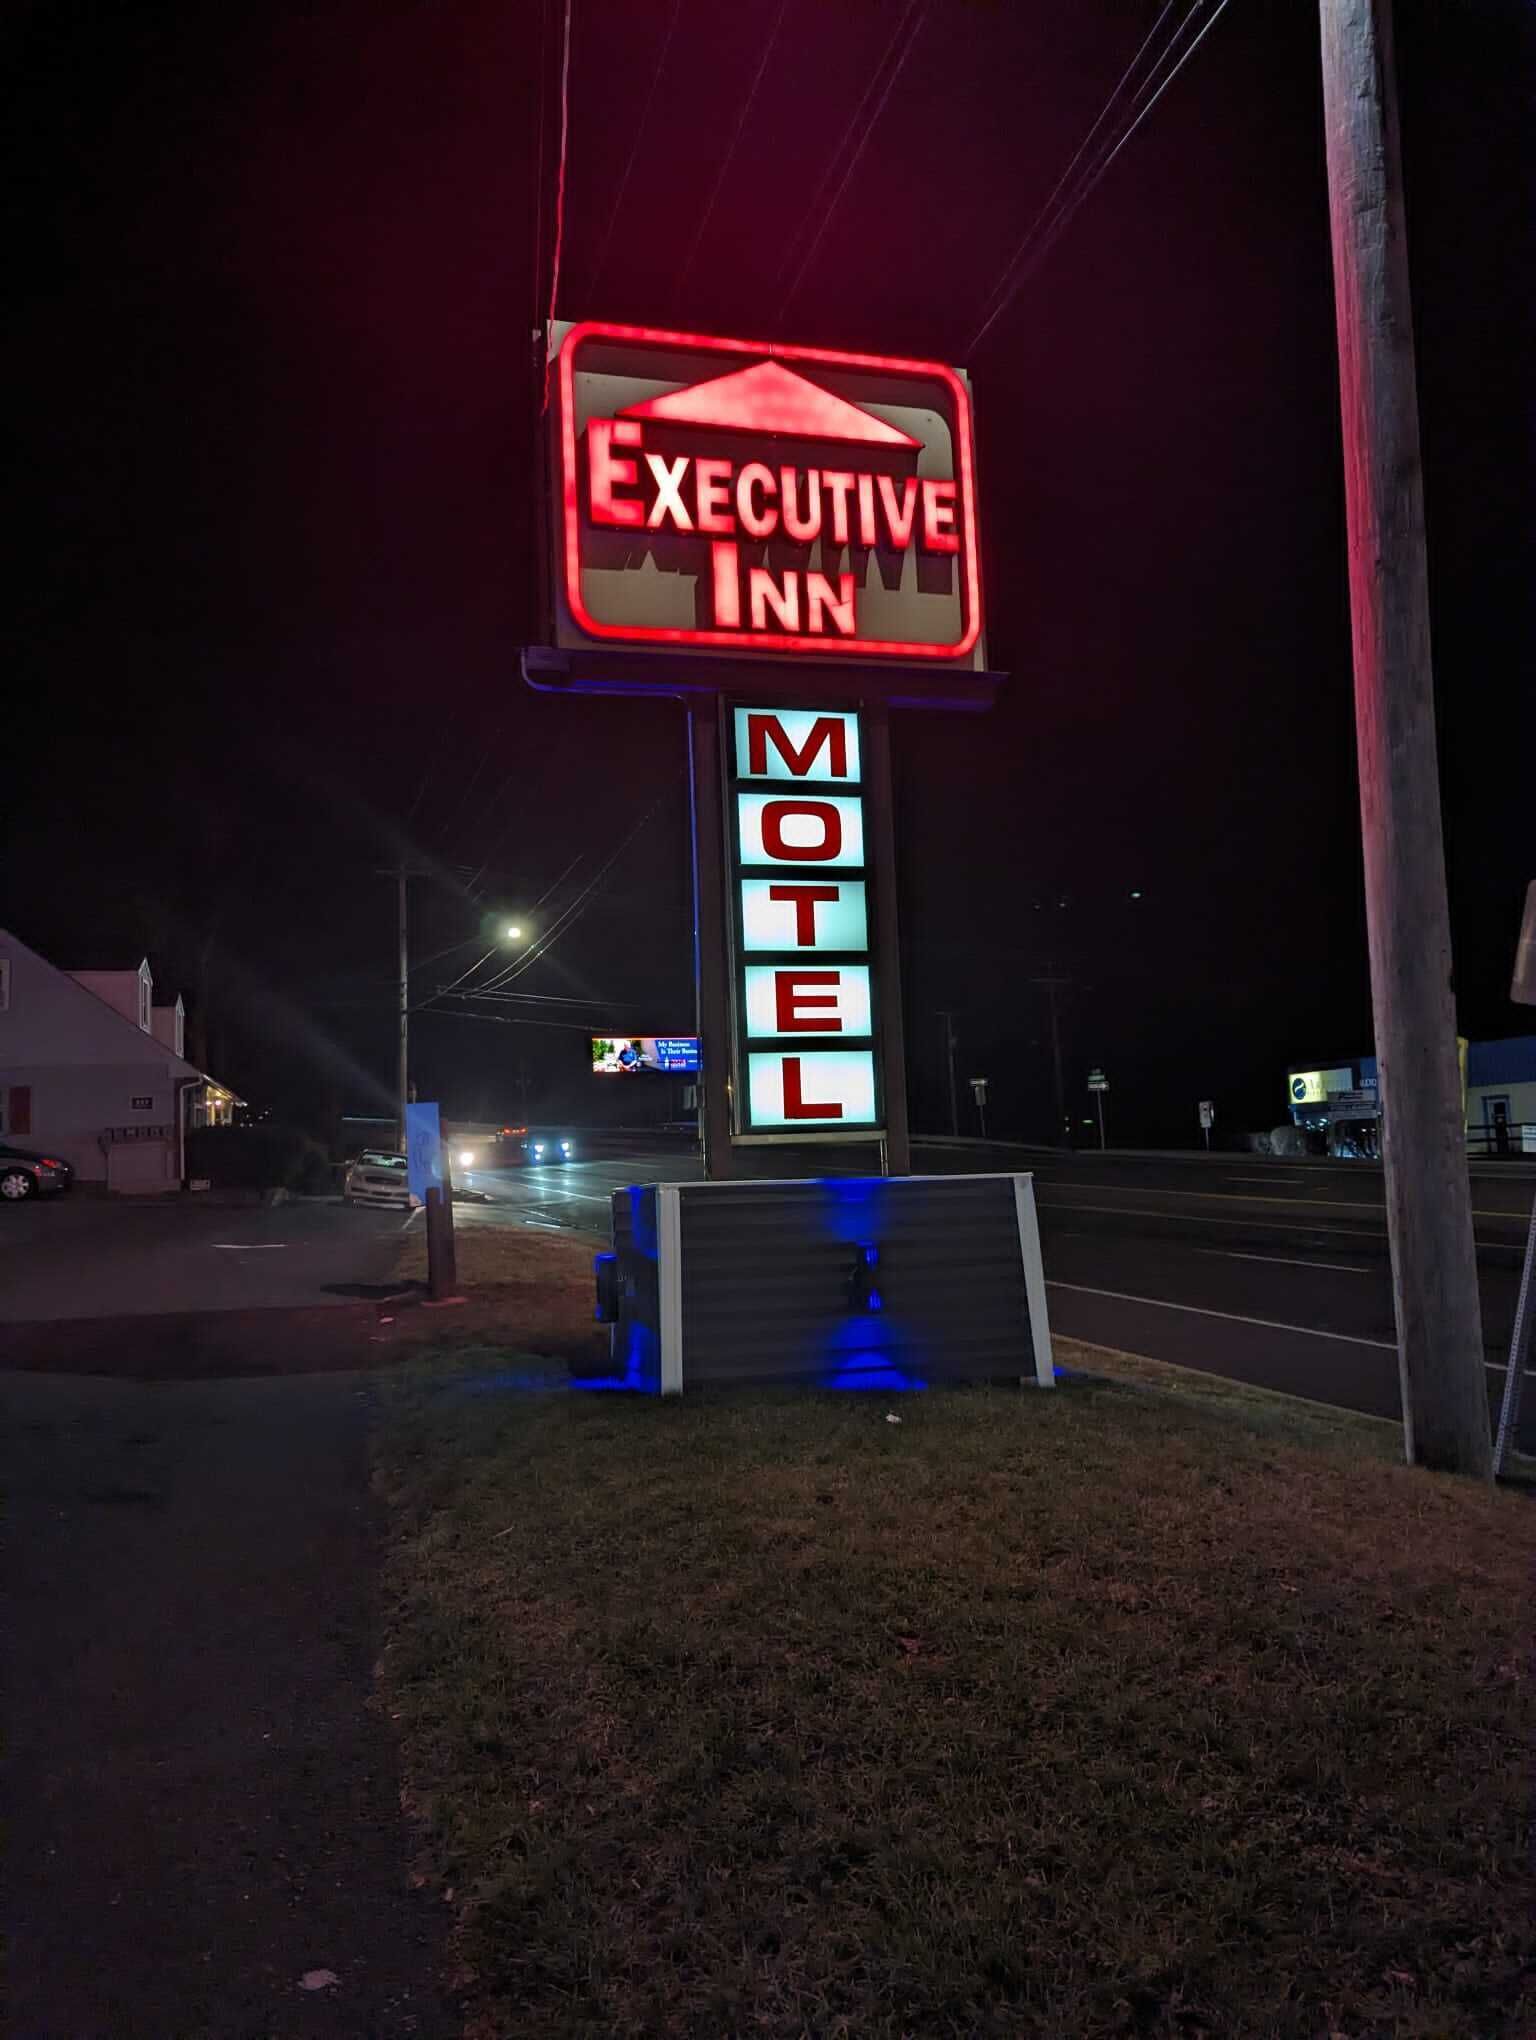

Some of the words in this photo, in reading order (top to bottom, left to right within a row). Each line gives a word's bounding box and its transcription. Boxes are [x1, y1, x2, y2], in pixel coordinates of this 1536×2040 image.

[587, 416, 960, 553] EXECUTIVE
[711, 539, 857, 635] INN
[747, 713, 848, 1120] MOTEL
